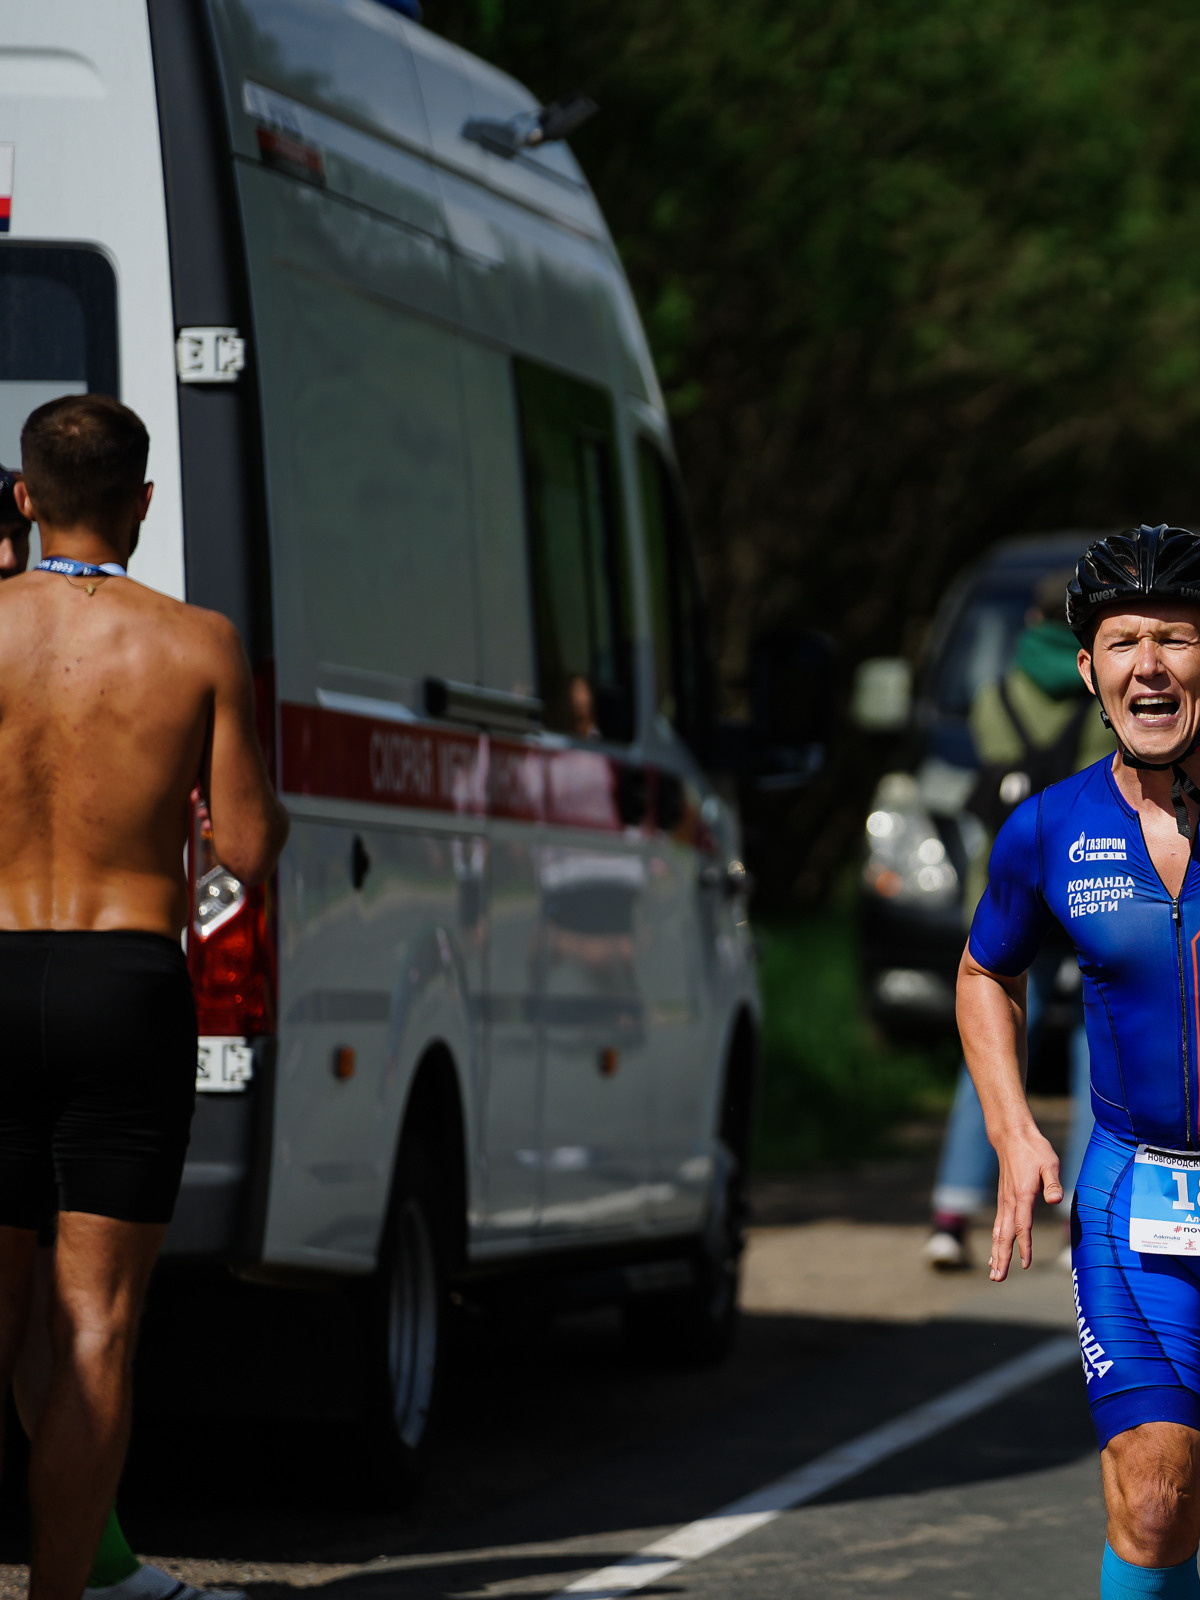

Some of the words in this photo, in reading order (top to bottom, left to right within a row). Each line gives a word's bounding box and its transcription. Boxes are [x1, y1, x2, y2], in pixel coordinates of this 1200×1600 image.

[1089, 588, 1118, 603] uvex
[1086, 838, 1126, 850] ГАЗПРОМ
[1086, 852, 1126, 860] НЕФТЬ
[1067, 876, 1136, 893] КОМАНДА
[1068, 888, 1134, 906] ГАЗПРОМ
[1070, 901, 1119, 918] НЕФТИ
